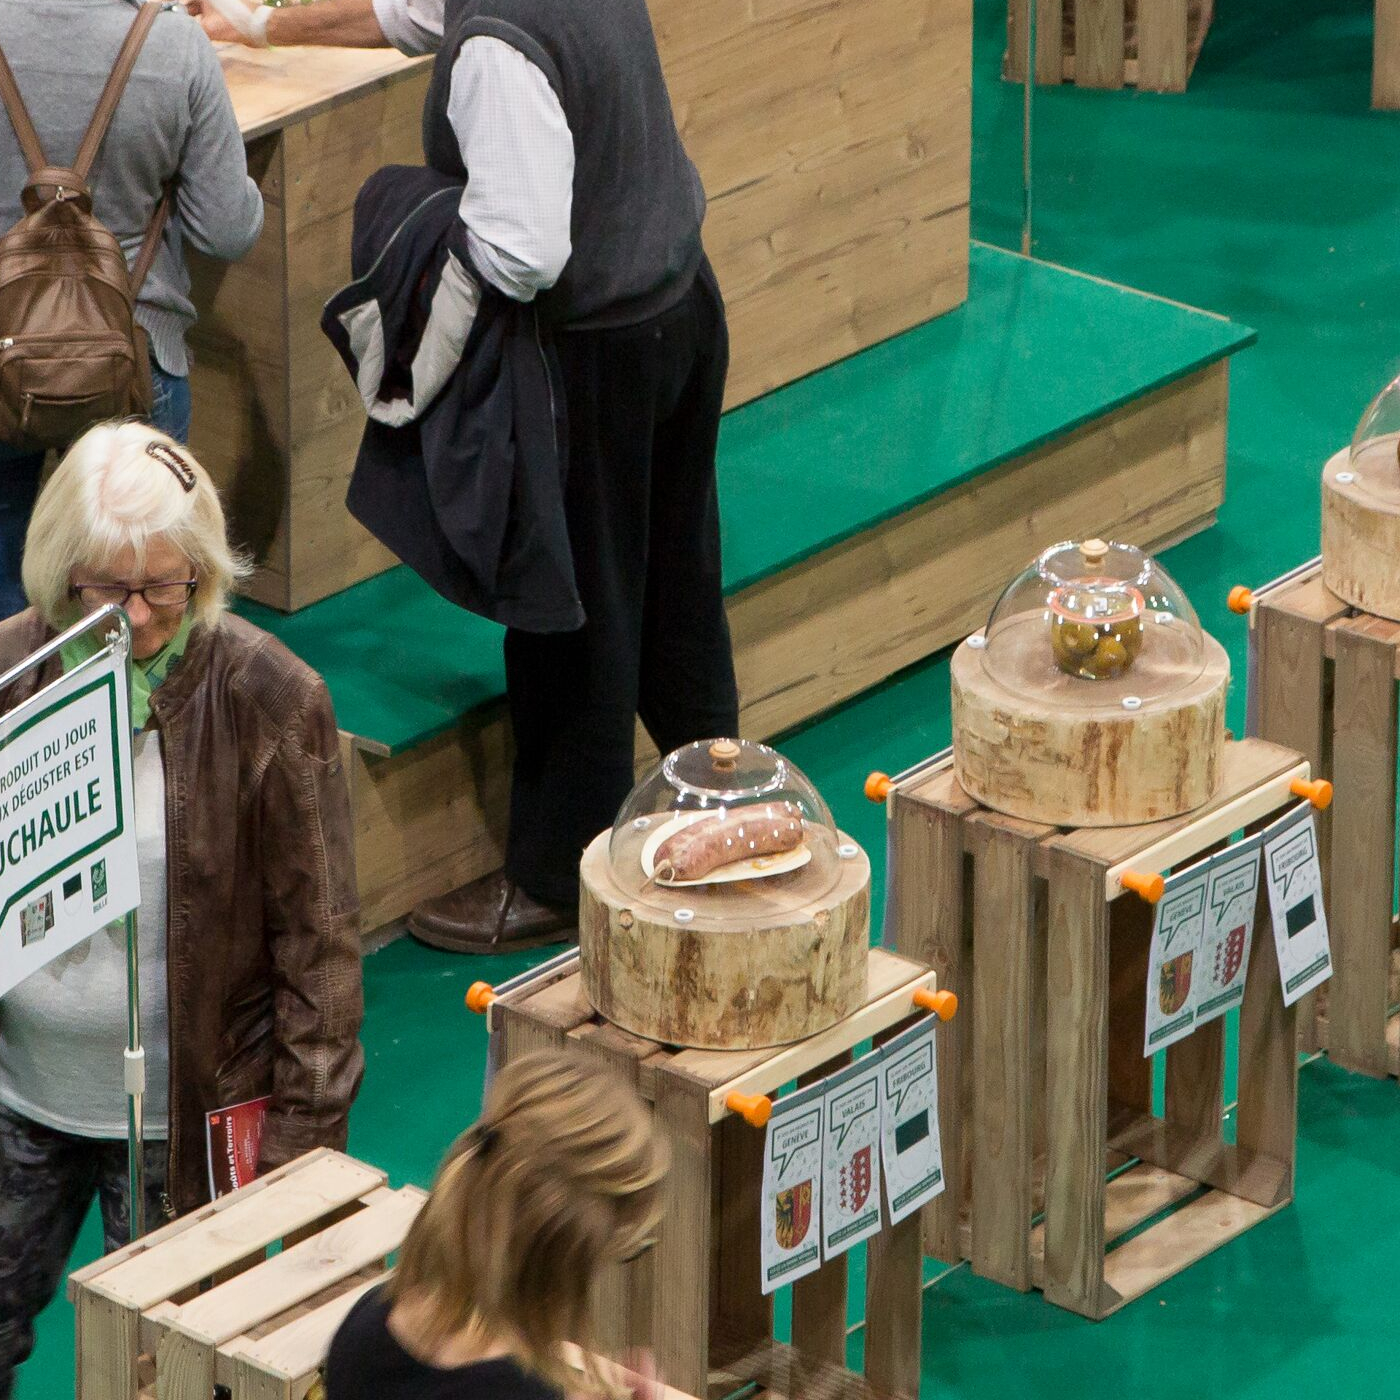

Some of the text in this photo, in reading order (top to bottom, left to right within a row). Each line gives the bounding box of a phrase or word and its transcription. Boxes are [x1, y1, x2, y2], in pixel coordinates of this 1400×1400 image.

[43, 738, 61, 763] DU
[65, 718, 97, 750] JOUR
[12, 760, 72, 813] DÉGUSTER
[75, 744, 97, 772] EST
[892, 1061, 927, 1089] FRIBOURG
[842, 1100, 866, 1118] VALAIS
[226, 1116, 234, 1154] Terroirs
